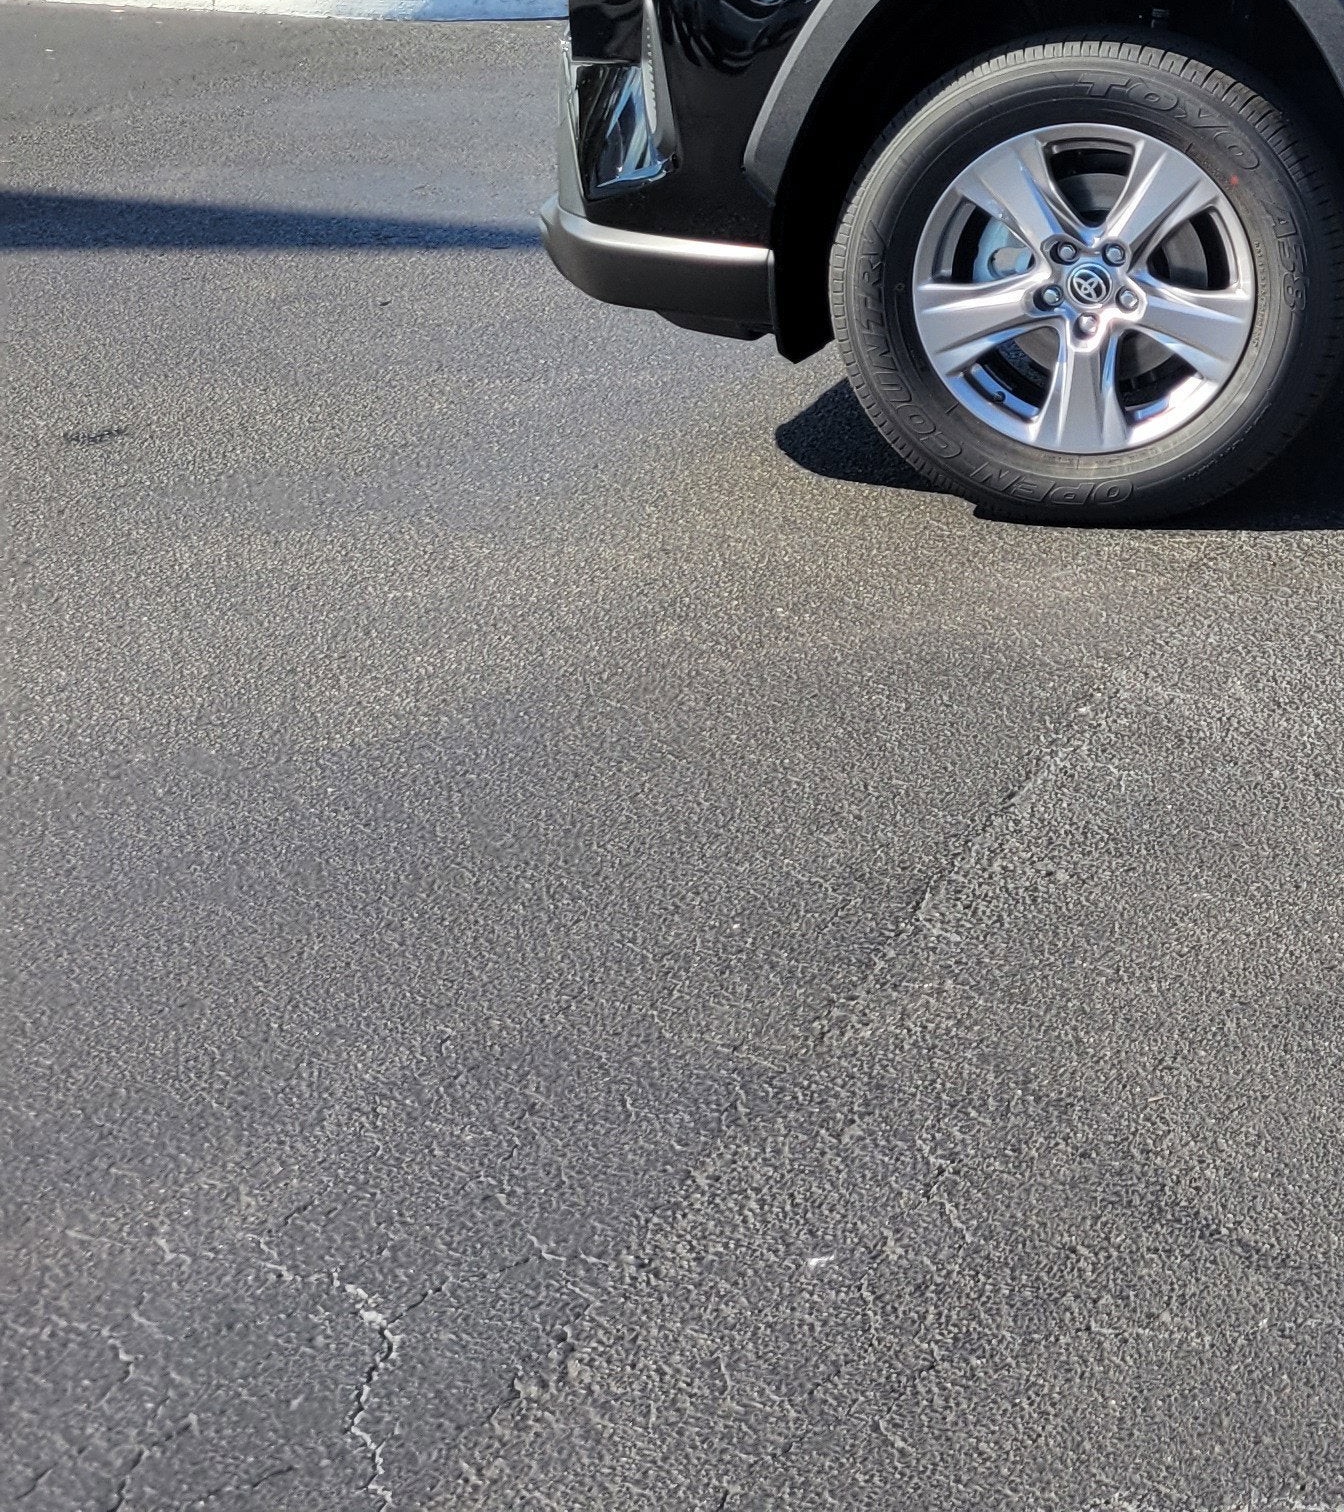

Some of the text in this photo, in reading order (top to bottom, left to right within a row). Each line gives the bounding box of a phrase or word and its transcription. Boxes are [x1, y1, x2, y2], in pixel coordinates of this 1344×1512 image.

[1078, 71, 1260, 170] TOYO
[854, 220, 1134, 506] OPEN COUNTRY
